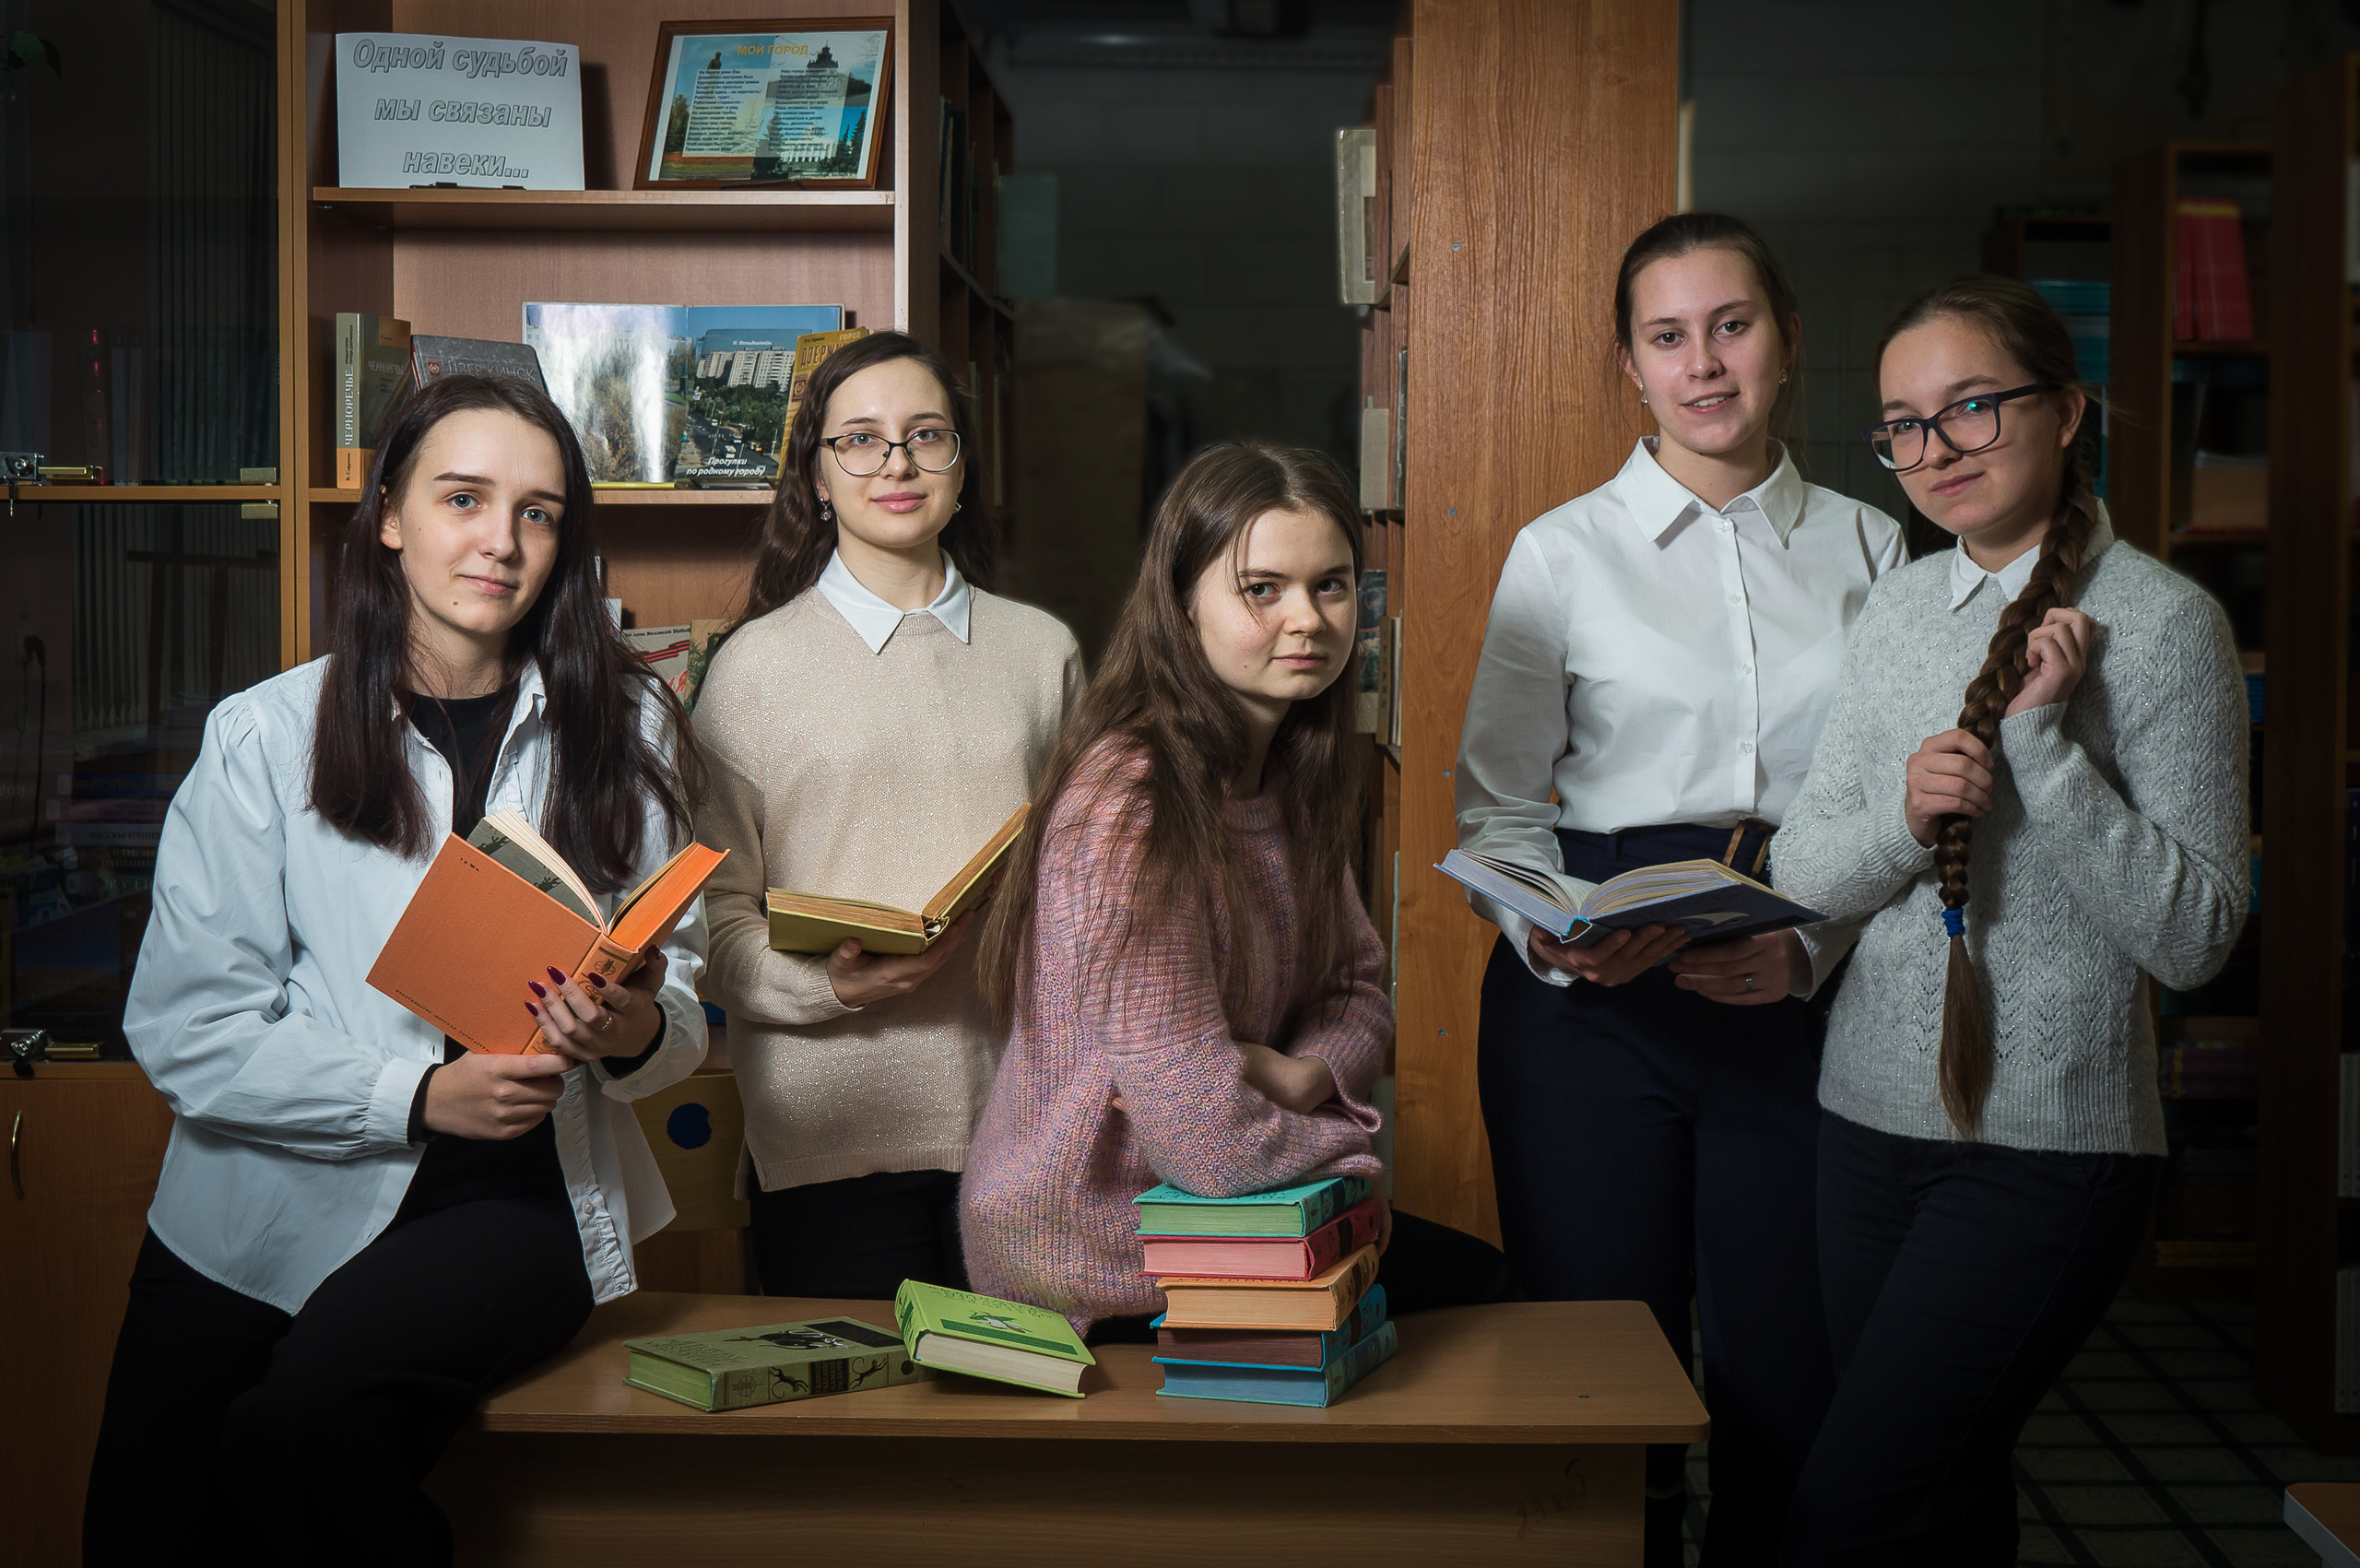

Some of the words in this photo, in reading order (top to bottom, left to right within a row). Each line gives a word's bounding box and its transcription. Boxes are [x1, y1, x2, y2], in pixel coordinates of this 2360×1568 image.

[353, 38, 446, 74] Одной
[452, 46, 568, 79] судьбой
[738, 43, 765, 55] МОЙ
[767, 44, 808, 56] ГОРОД
[374, 99, 421, 121] мы
[428, 100, 552, 128] связаны
[402, 151, 530, 179] навеки...
[345, 366, 354, 445] ЧЕРНОРЕЧЬЕ.
[697, 467, 735, 477] родному
[708, 456, 748, 466] Прогулки
